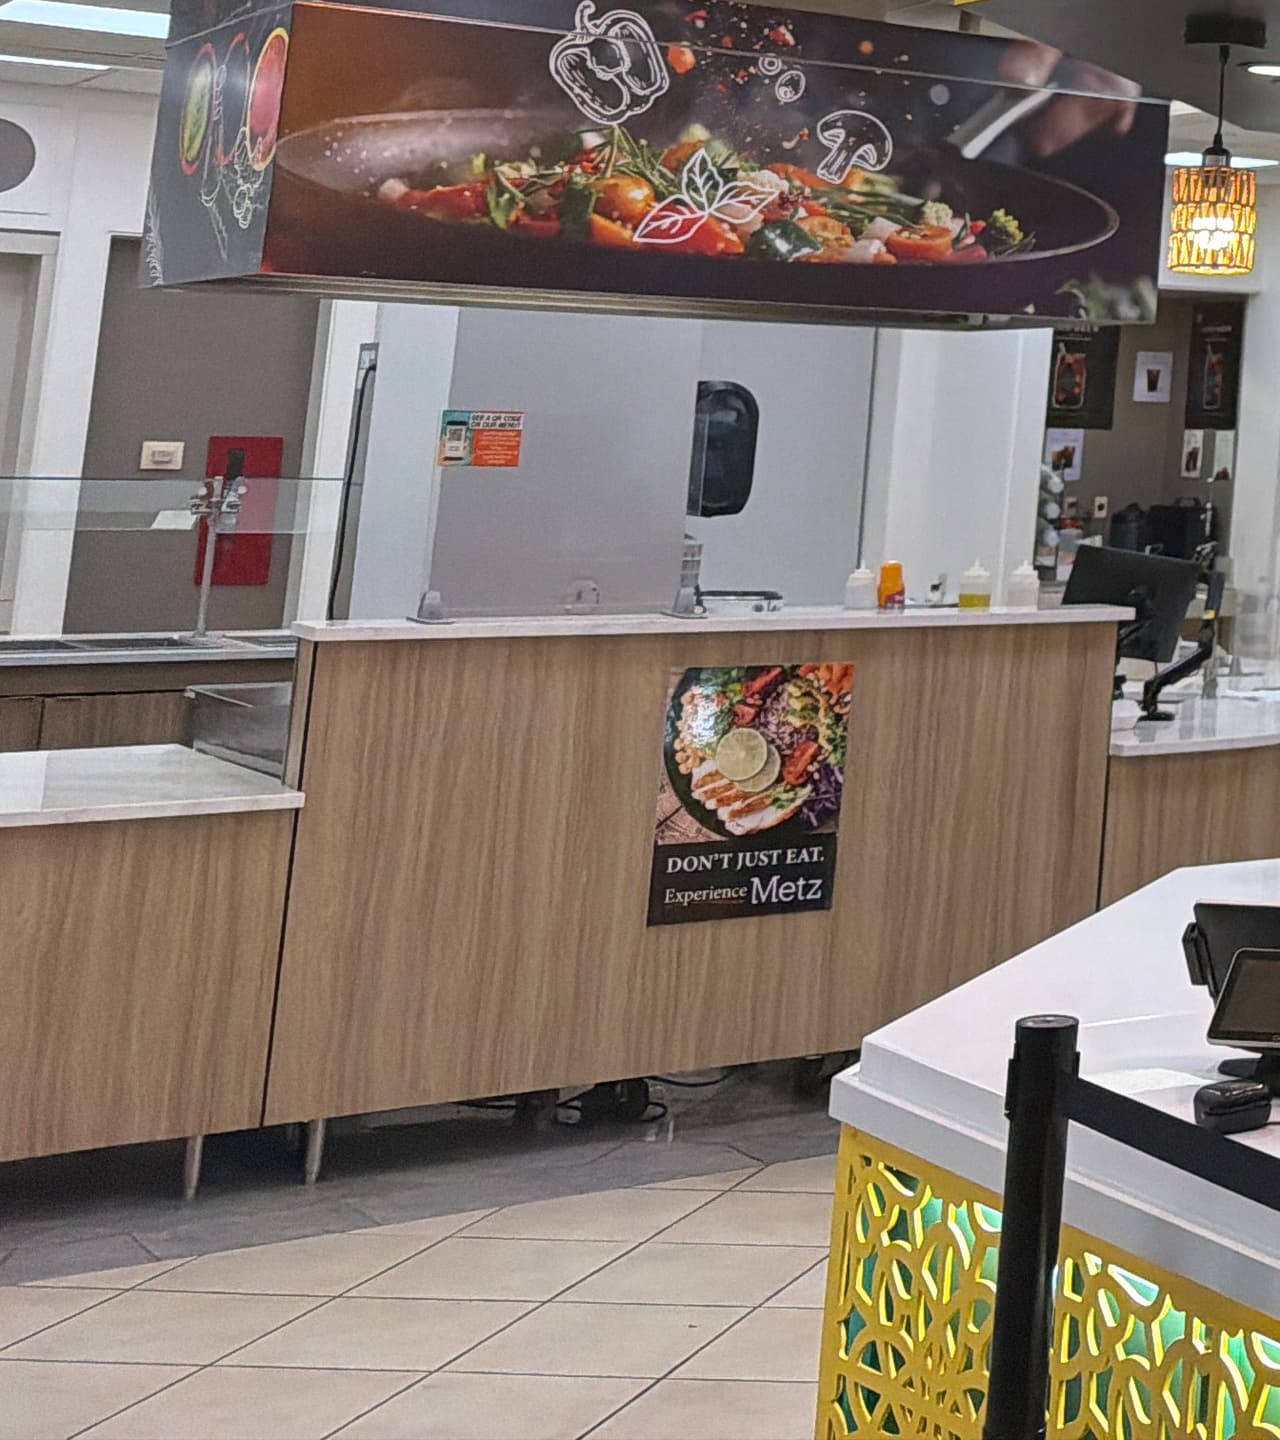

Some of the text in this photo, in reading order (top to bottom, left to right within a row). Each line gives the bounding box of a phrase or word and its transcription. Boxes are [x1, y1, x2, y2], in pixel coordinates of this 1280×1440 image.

[667, 846, 825, 873] DON'T JUST EAT.
[664, 875, 824, 906] Experience Metz
